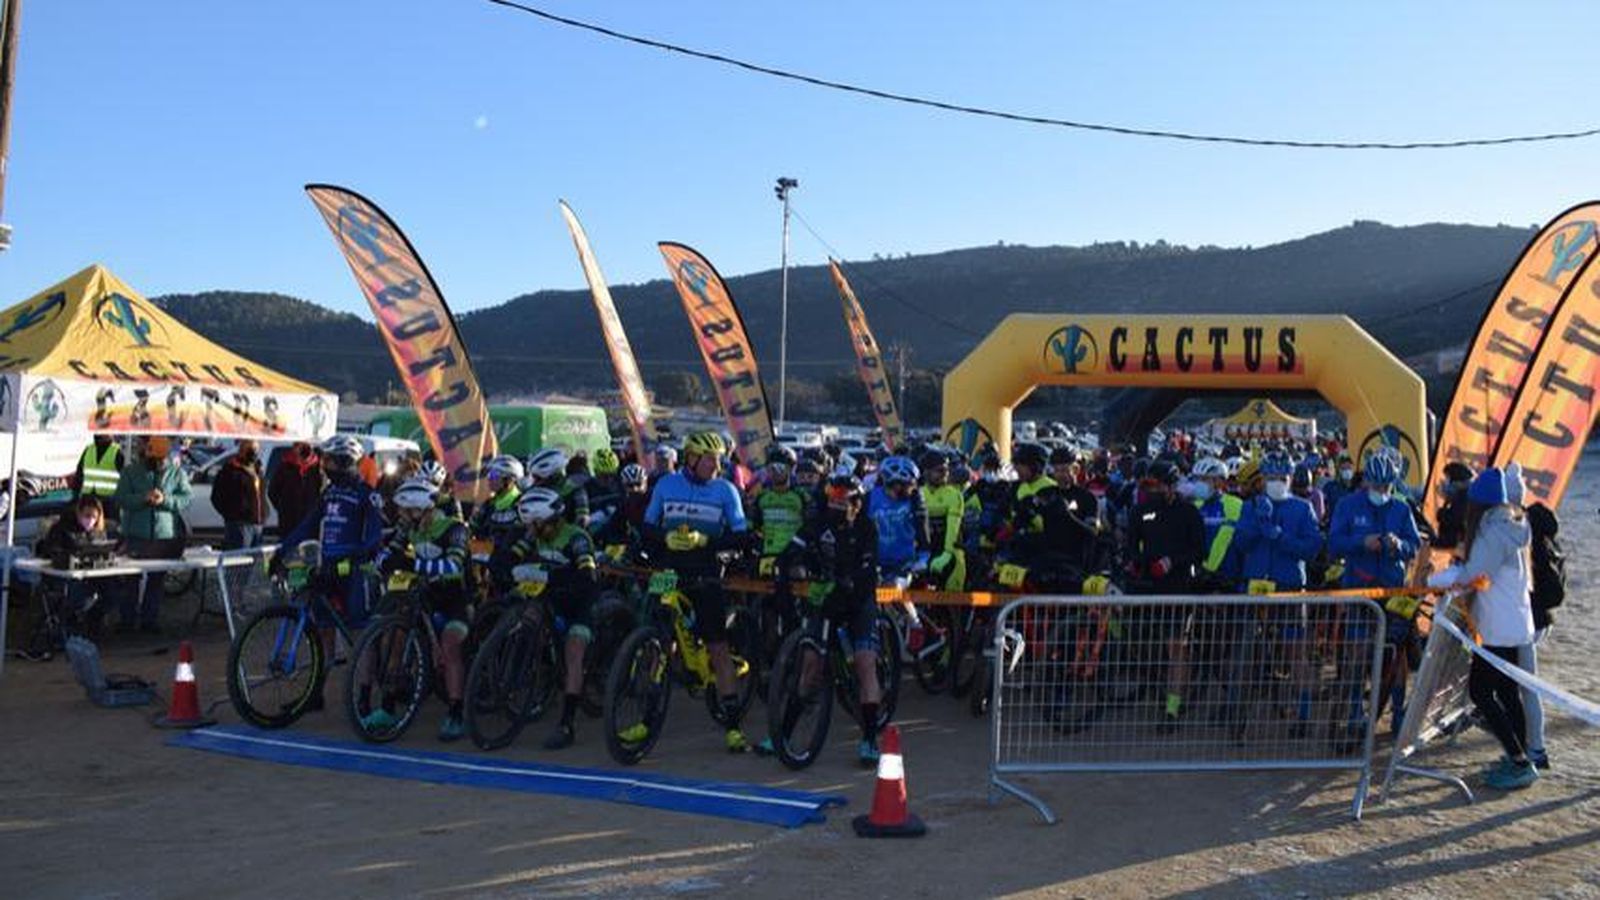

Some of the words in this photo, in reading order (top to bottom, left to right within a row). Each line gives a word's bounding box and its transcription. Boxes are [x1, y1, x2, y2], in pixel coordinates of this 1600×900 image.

[67, 358, 263, 388] CACTUS
[1109, 327, 1297, 373] CACTUS
[94, 385, 281, 434] CACTUS
